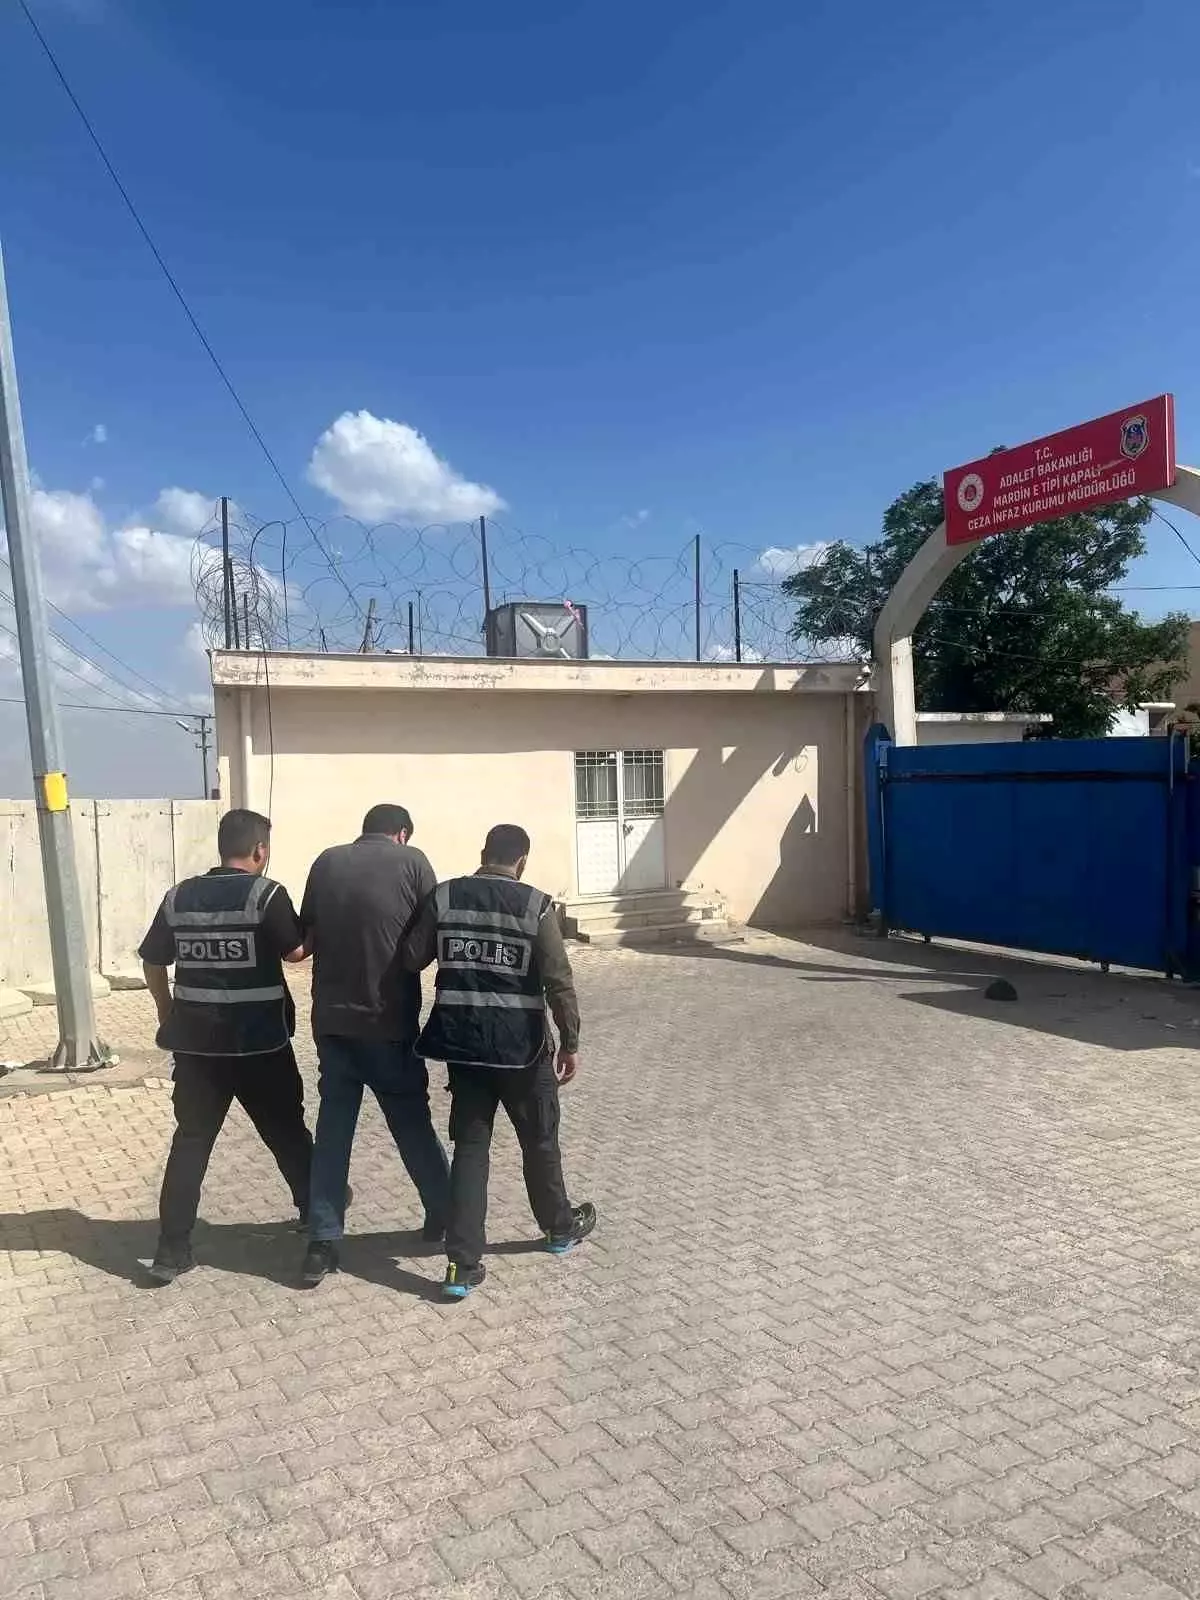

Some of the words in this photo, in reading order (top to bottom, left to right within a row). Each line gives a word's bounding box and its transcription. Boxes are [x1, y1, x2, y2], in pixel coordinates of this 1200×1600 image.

[999, 467, 1035, 489] ADALET
[1037, 448, 1093, 476] BAKANLIĞI
[1035, 447, 1053, 460] T.C.
[968, 515, 991, 531] CEZA
[993, 505, 1020, 524] İNFAZ
[1022, 495, 1064, 516] KURUMU
[1067, 468, 1136, 503] MÜDÜRLÜĞÜ
[993, 487, 1031, 508] MARDİN
[1033, 484, 1039, 496] E
[1042, 476, 1060, 494] TİPİ
